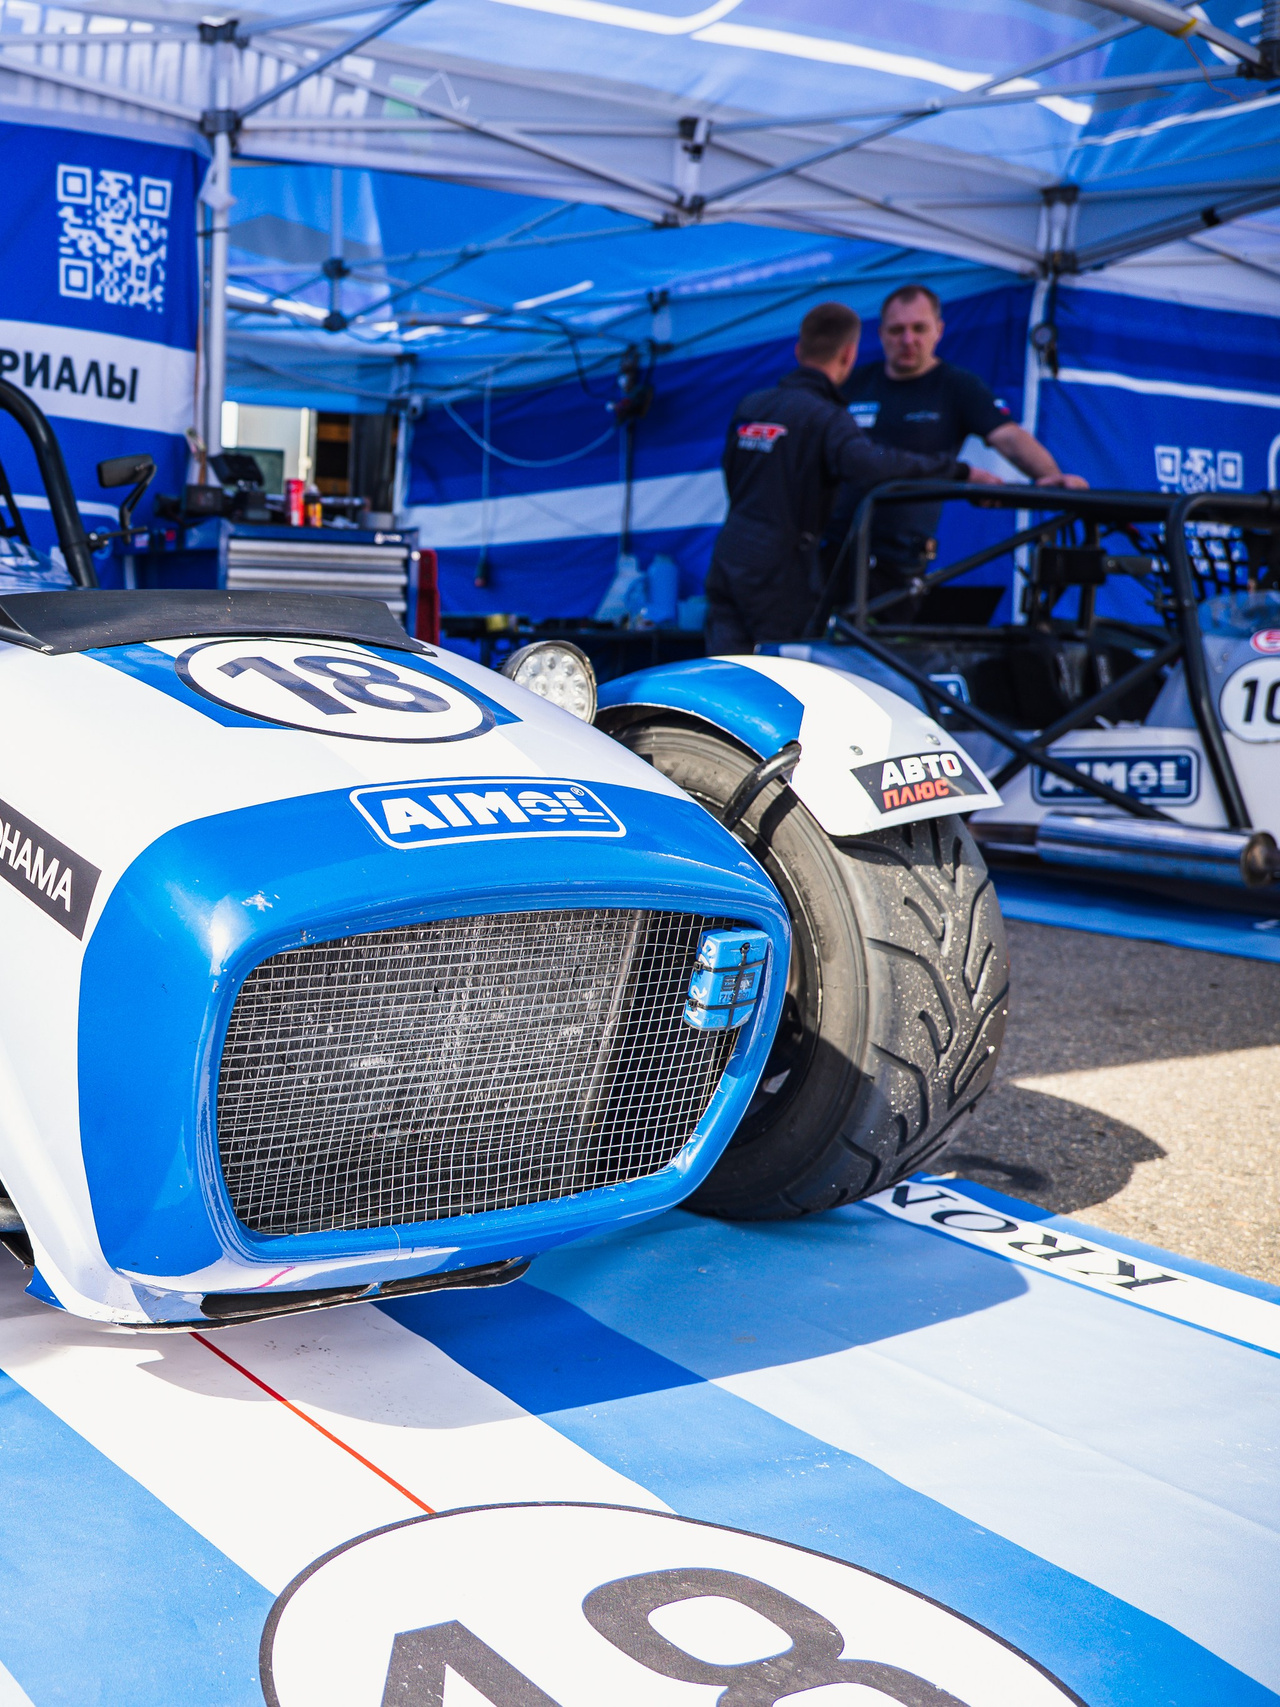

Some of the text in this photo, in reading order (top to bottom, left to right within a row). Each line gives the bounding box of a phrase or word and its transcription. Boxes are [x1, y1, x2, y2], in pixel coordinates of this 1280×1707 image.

[216, 655, 451, 715] 18
[881, 753, 963, 791] АВТО
[882, 779, 950, 810] ПЛЮС
